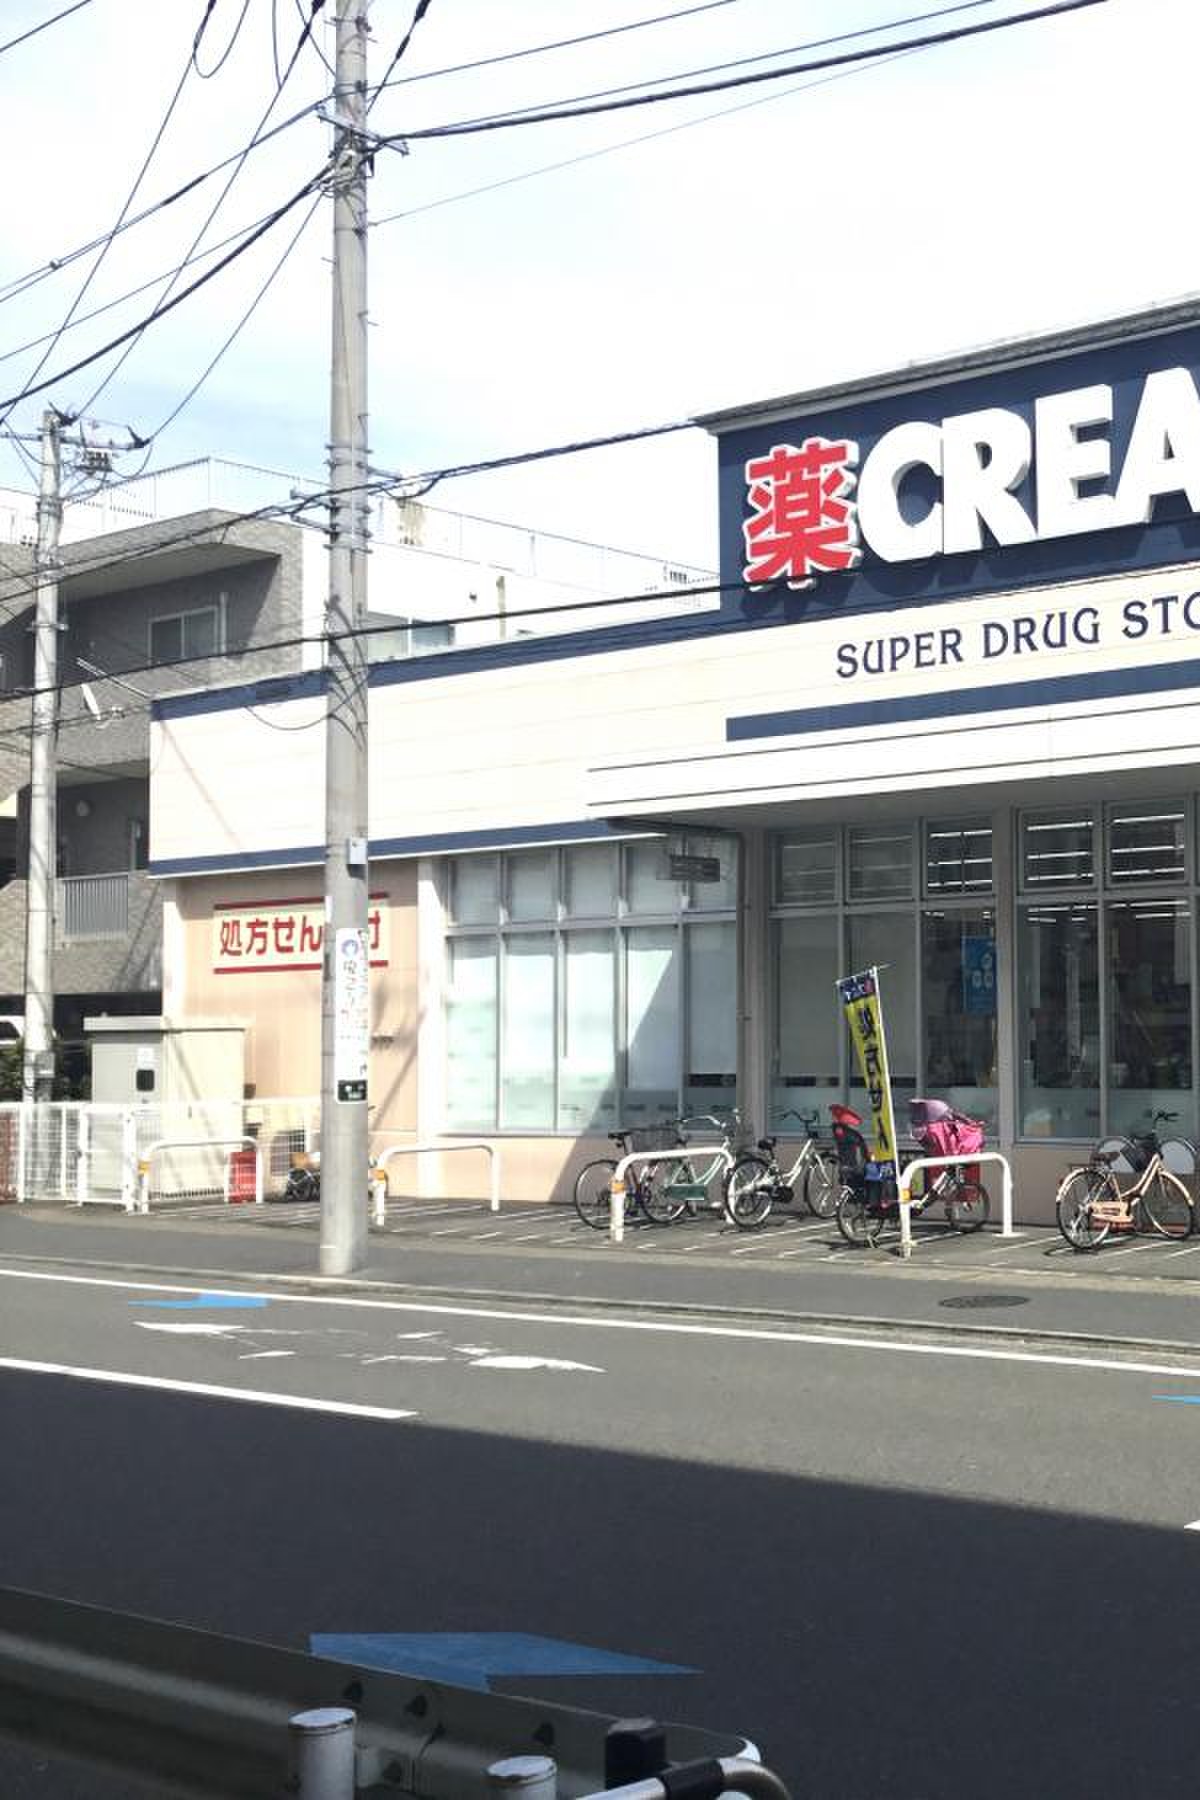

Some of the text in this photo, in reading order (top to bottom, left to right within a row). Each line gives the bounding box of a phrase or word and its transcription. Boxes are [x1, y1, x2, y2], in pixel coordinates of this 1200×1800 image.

[743, 436, 861, 592] 薬
[836, 627, 963, 678] SUPER
[982, 607, 1100, 659] DRUG
[220, 911, 381, 956] 処方せん付
